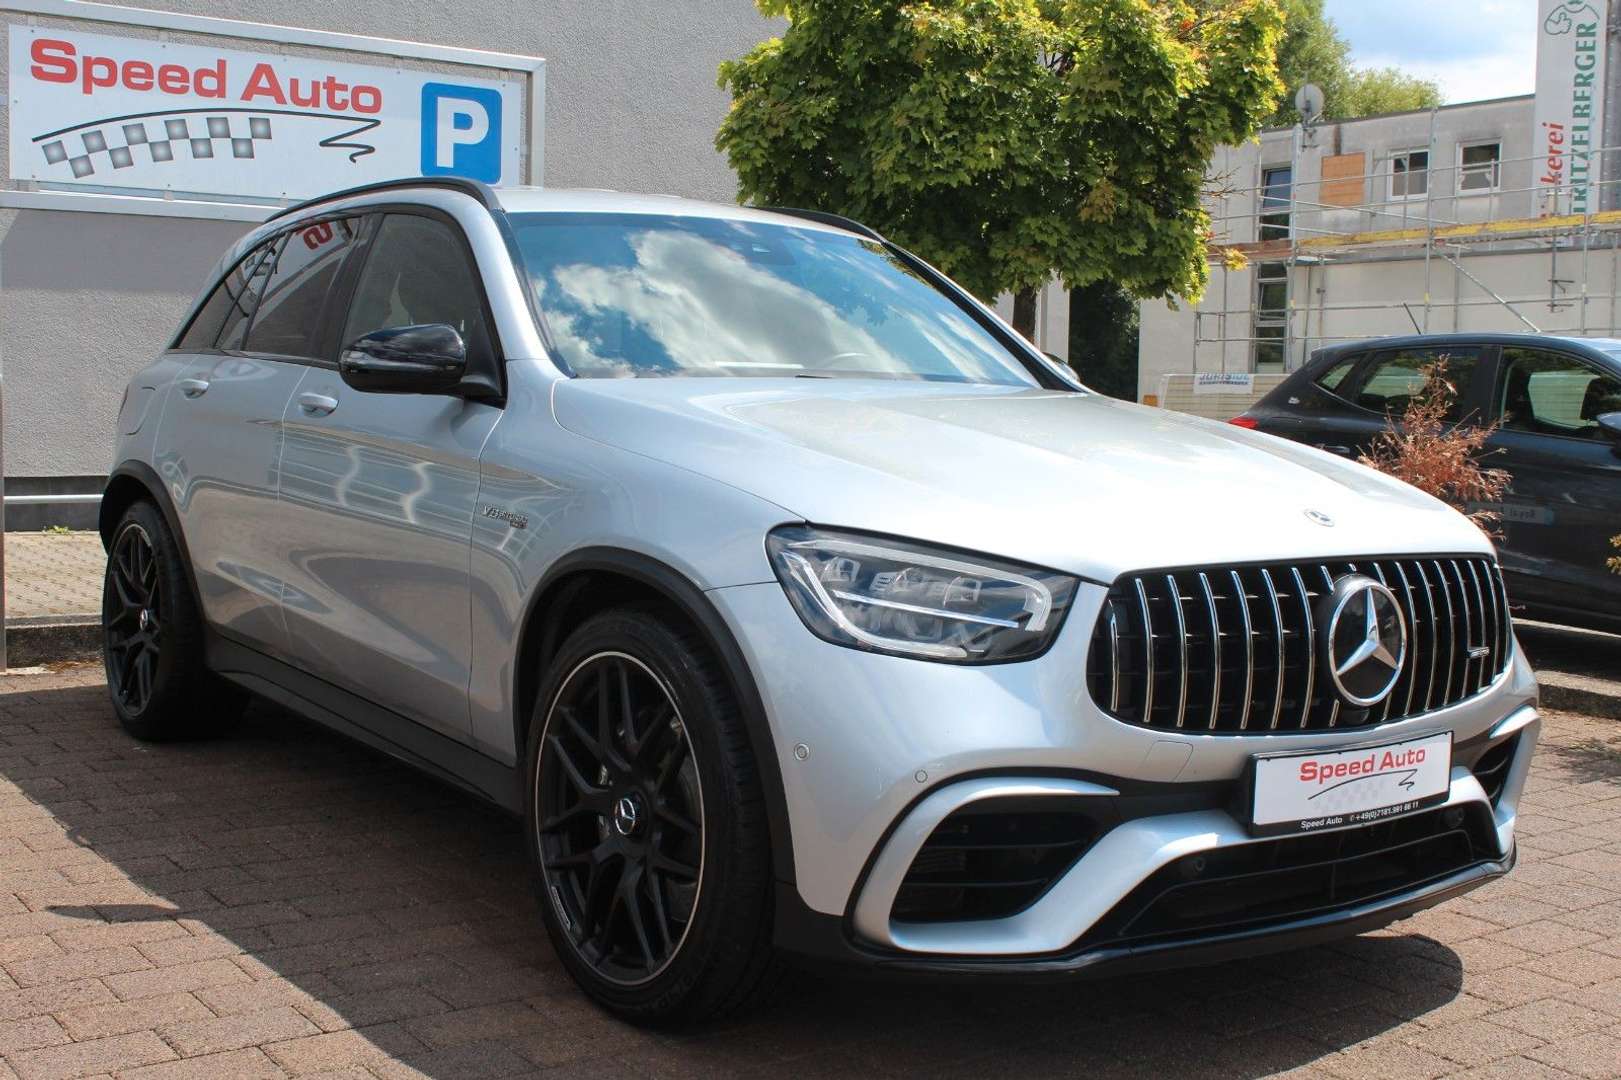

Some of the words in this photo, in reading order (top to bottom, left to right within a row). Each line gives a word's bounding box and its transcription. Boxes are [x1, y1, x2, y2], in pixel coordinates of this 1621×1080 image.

[30, 38, 227, 99] Speed
[240, 63, 383, 114] Auto
[436, 96, 489, 169] P
[1300, 754, 1375, 784] Speed
[1380, 747, 1425, 771] Auto
[1301, 819, 1325, 830] Speed
[1326, 816, 1343, 825] Auto
